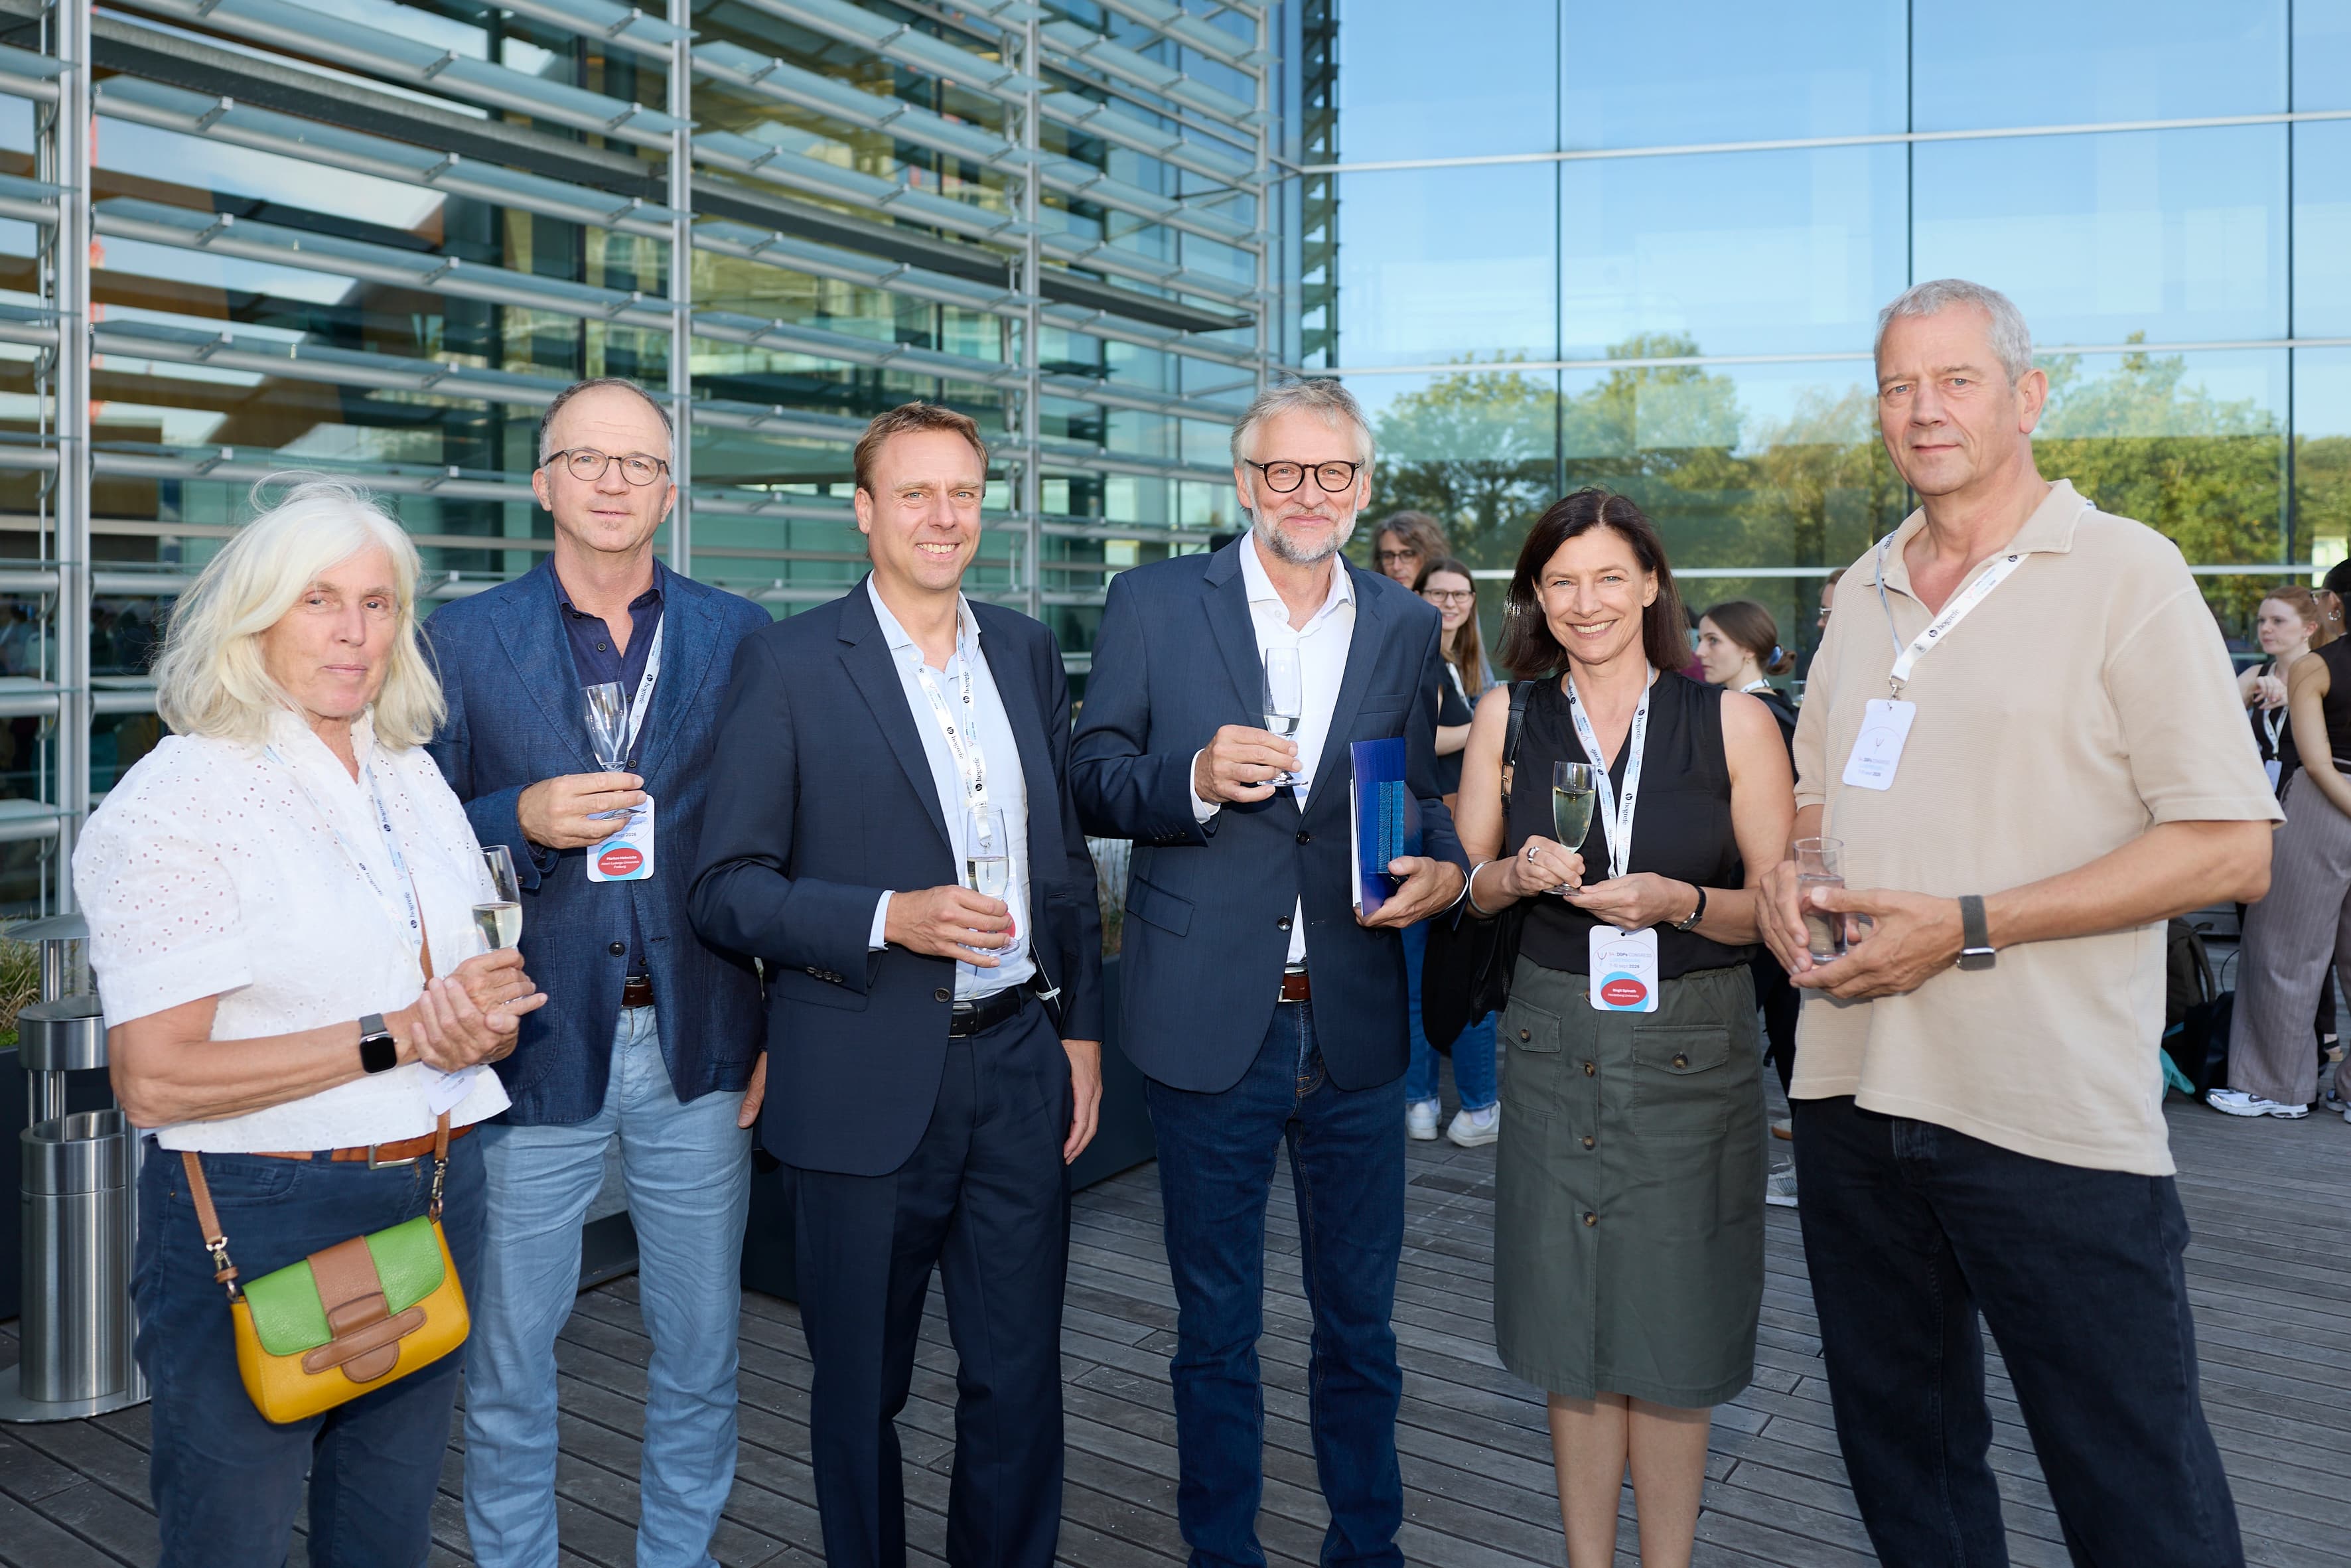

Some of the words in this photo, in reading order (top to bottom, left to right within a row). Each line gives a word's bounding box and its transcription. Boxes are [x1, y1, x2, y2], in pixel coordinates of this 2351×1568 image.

[1936, 608, 1960, 631] hogrefe
[639, 682, 651, 705] hogrefe
[952, 735, 964, 760] hogrefe
[1591, 748, 1603, 768] hogrefe
[973, 757, 983, 782] hogrefe
[1622, 802, 1632, 825] hogrefe
